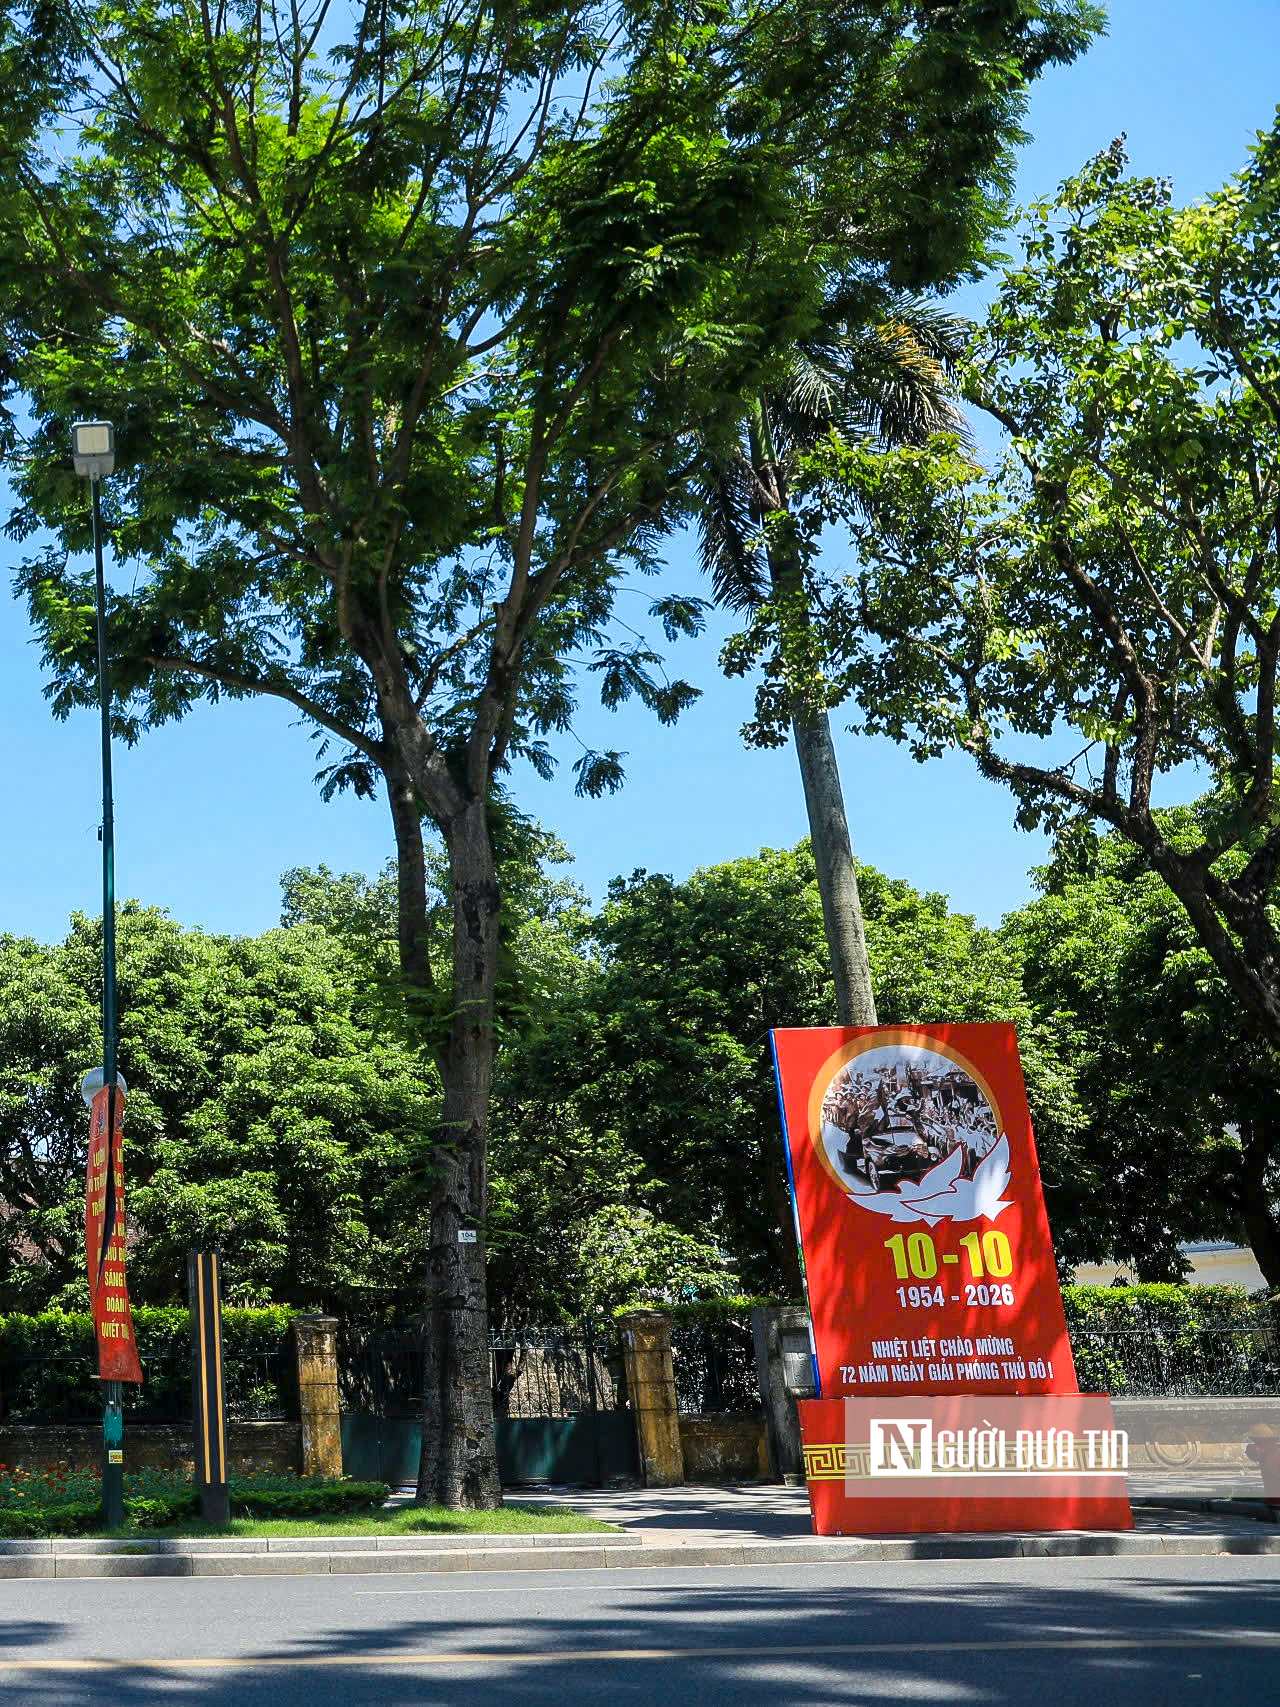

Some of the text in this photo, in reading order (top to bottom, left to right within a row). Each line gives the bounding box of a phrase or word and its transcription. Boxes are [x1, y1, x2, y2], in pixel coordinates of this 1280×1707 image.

[896, 1285, 945, 1308] 1954
[966, 1284, 1014, 1307] 2026
[872, 1336, 1014, 1362] NHIỆT LIỆT CHÀO MỪNG
[839, 1366, 857, 1384] 72
[858, 1362, 889, 1383] NĂM
[891, 1361, 925, 1382] NGÀY
[928, 1359, 954, 1381] GIẢI
[956, 1360, 999, 1381] PHÓNG
[1001, 1356, 1025, 1380] THỦ
[1027, 1359, 1047, 1379] ĐÔ
